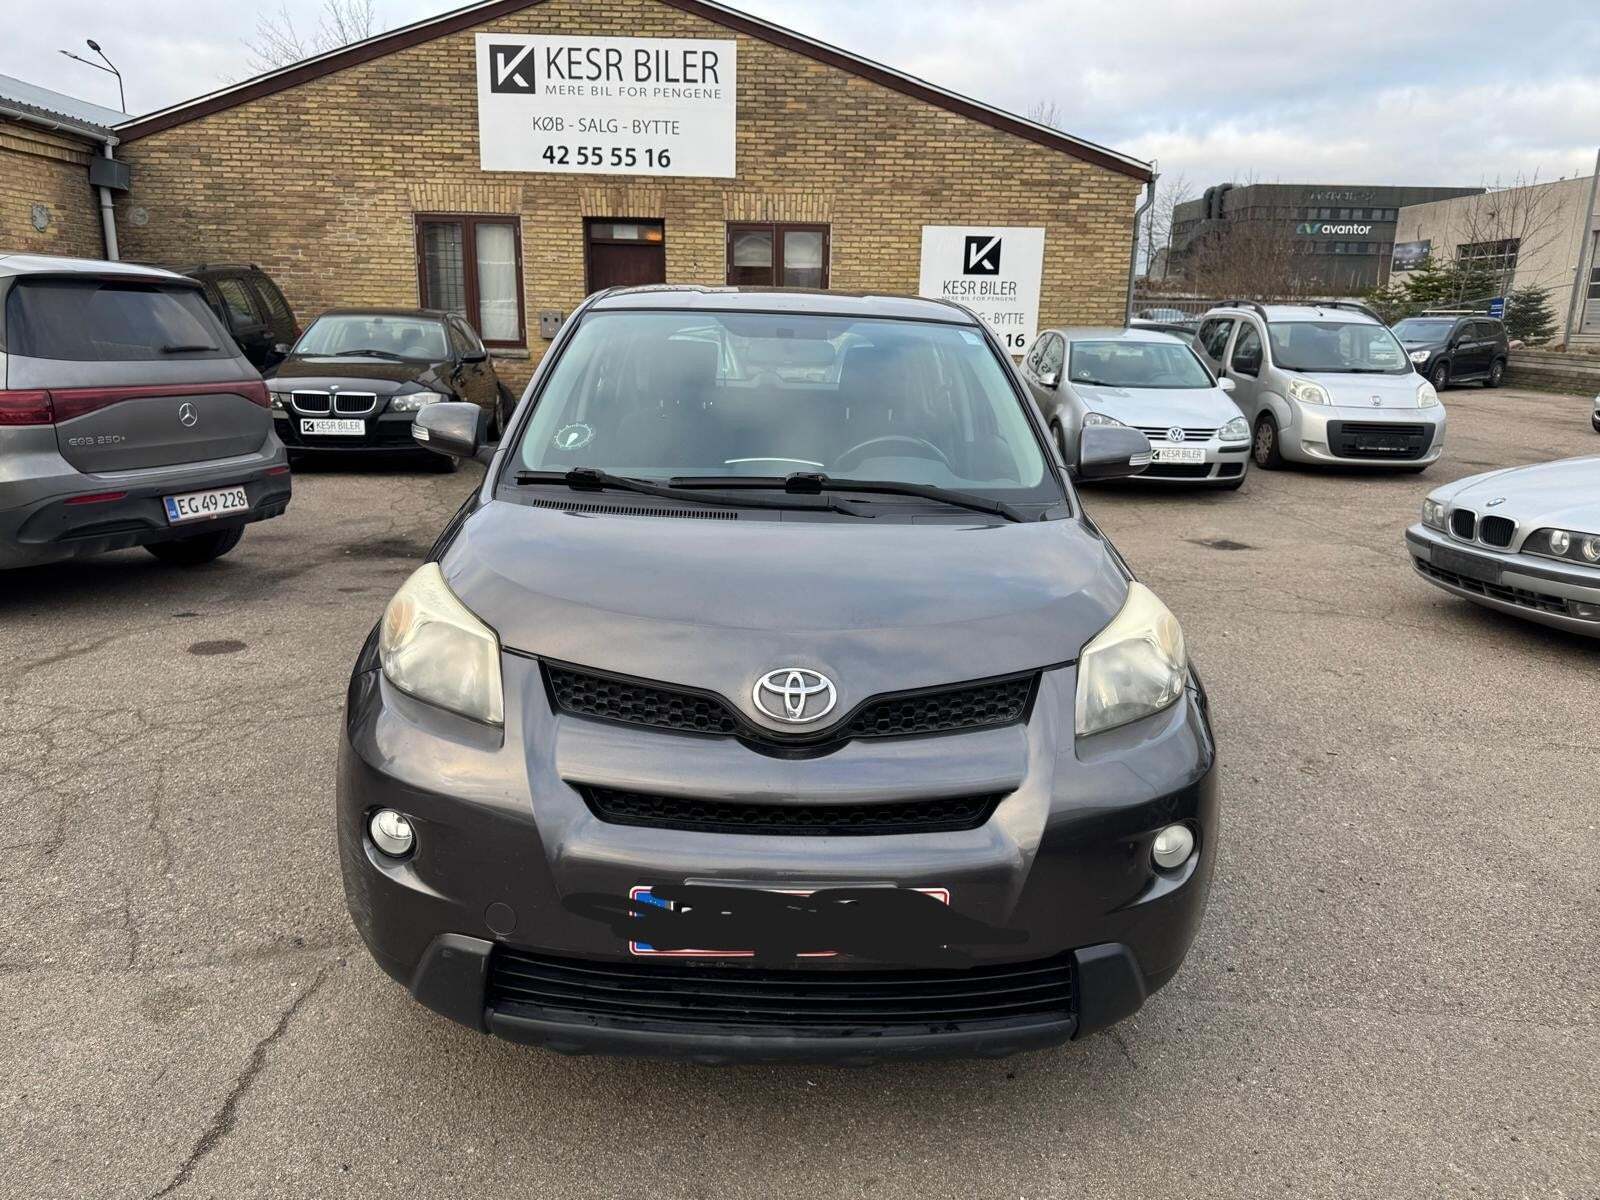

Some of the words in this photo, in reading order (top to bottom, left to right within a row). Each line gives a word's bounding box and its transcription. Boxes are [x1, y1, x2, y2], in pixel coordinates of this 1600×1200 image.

[546, 47, 623, 82] KESR
[635, 49, 719, 84] BILER
[545, 85, 584, 96] MERE
[591, 86, 613, 97] BIL
[619, 86, 647, 97] FOR
[653, 87, 721, 99] PENGENE
[532, 116, 564, 132] KØB
[578, 117, 618, 133] SALG
[632, 119, 680, 135] BYTTE
[542, 145, 570, 165] 42
[576, 146, 604, 166] 55
[610, 147, 637, 167] 55
[645, 148, 671, 168] 16
[1321, 223, 1372, 235] avantor
[943, 280, 976, 295] KESR
[980, 281, 1017, 296] BILER
[993, 312, 1025, 325] BYTTE
[1006, 333, 1025, 348] 16
[316, 421, 336, 430] KESR
[337, 421, 361, 430] BILER
[177, 497, 200, 515] EG
[201, 494, 218, 511] 49
[220, 490, 246, 509] 228
